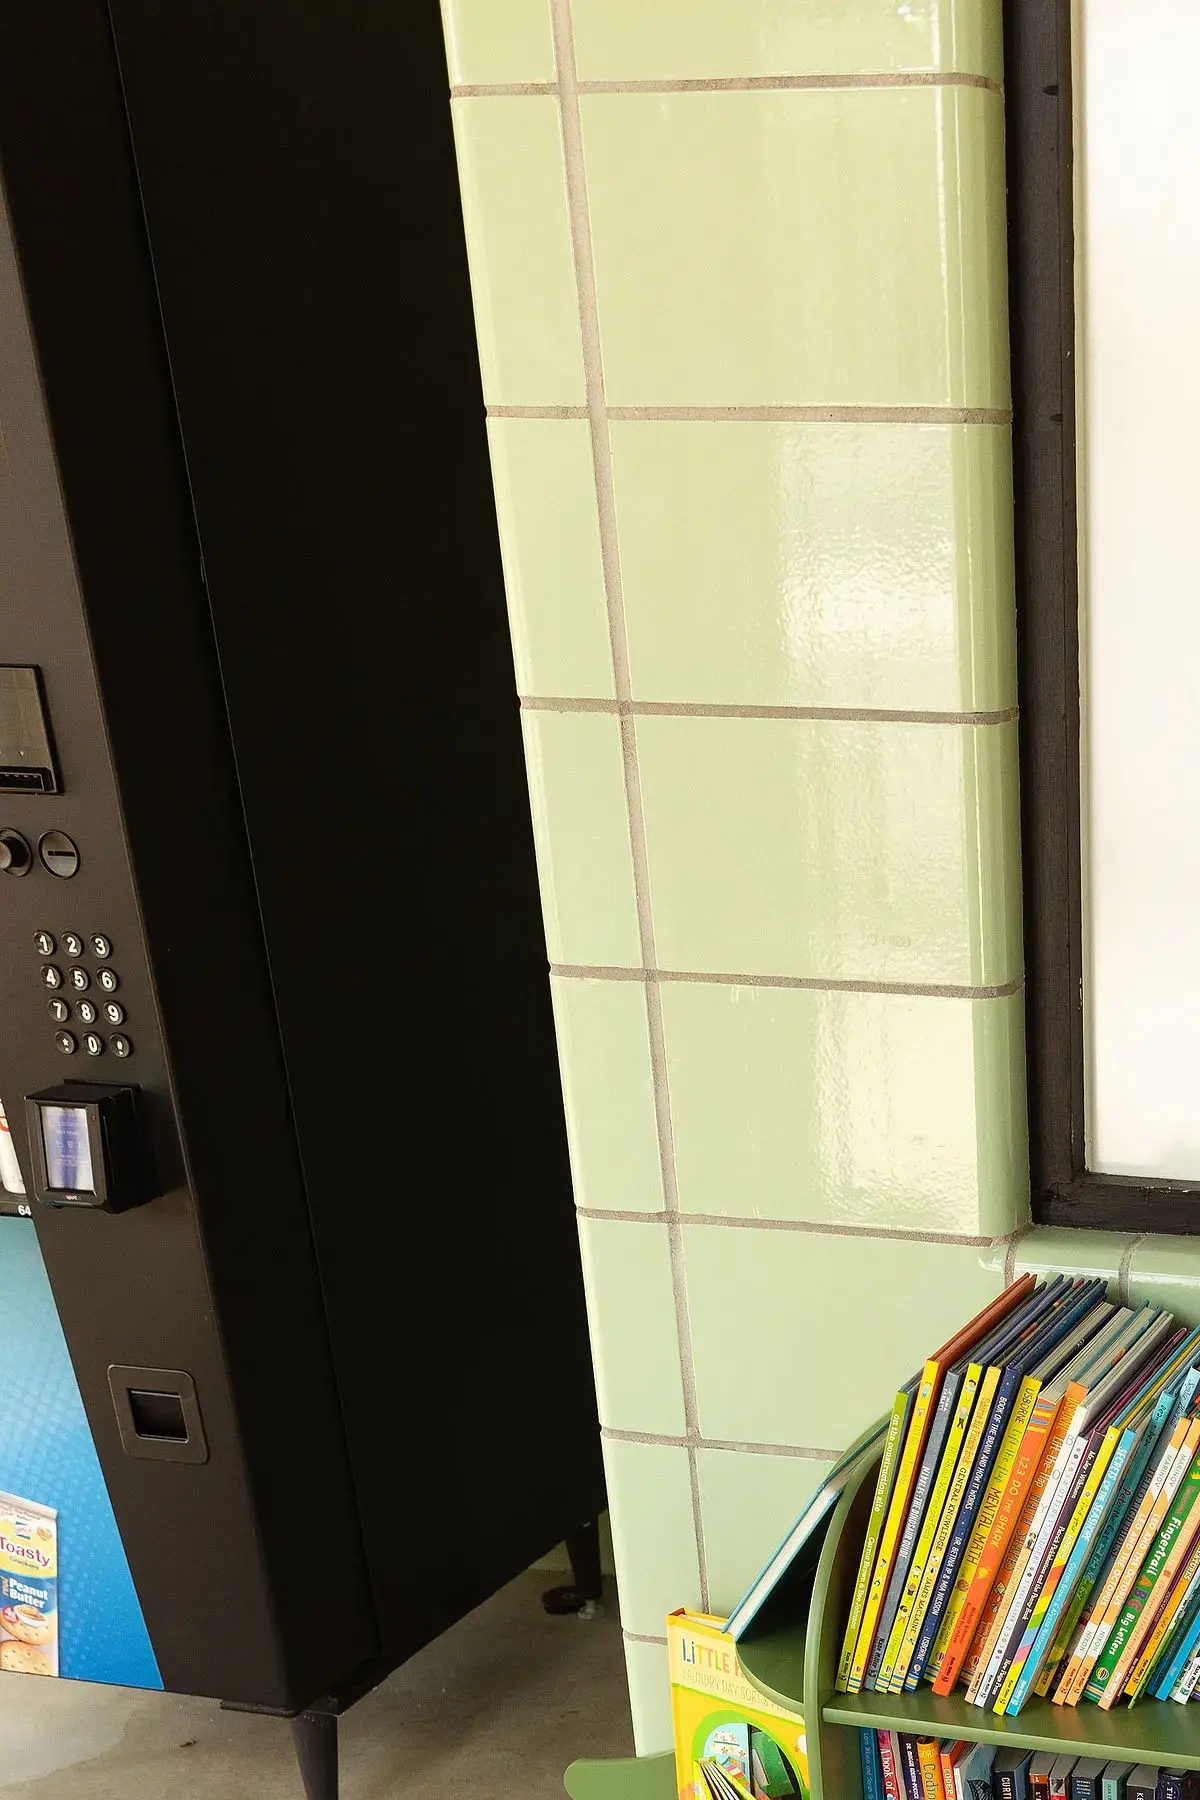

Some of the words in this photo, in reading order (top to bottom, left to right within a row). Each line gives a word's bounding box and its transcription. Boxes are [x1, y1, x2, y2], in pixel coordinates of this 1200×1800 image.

[40, 935, 48, 952] 1
[67, 936, 77, 953] 2
[95, 938, 105, 954] 3
[46, 968, 56, 985] 4
[74, 971, 84, 987] 5
[102, 971, 113, 989] 6
[53, 1003, 61, 1018] 7
[81, 1004, 91, 1020] 8
[108, 1005, 119, 1022] 9
[88, 1036, 98, 1053] 0
[18, 1205, 32, 1216] 64
[994, 1396, 1007, 1415] BOOK
[1014, 1387, 1035, 1424] USBORNE
[891, 1414, 899, 1424] on
[988, 1422, 998, 1434] THE
[992, 1414, 1001, 1423] OF
[888, 1425, 898, 1440] the
[982, 1434, 995, 1453] BRAIN
[877, 1441, 895, 1494] construction
[978, 1453, 988, 1466] AND
[973, 1466, 984, 1481] HOW
[950, 1466, 967, 1502] GENERAL
[970, 1481, 980, 1489] IT
[1007, 1478, 1021, 1496] DO
[873, 1495, 884, 1512] site
[964, 1488, 977, 1510] WORKS
[976, 1486, 1002, 1531] MENTAL
[1002, 1498, 1013, 1513] THE
[935, 1503, 955, 1551] KNOWLEDGE
[989, 1514, 1008, 1547] SHARK
[1146, 1512, 1160, 1530] LEO
[1052, 1525, 1064, 1544] Patrick
[1137, 1529, 1152, 1549] AND
[0, 1536, 50, 1567] Toasty
[965, 1532, 986, 1565] MATH
[1143, 1514, 1182, 1576] Fingertrail
[1038, 1543, 1057, 1577] Picklebottom
[1131, 1548, 1144, 1564] THE
[9, 1577, 49, 1601] Peanut
[1031, 1586, 1039, 1595] the
[1034, 1576, 1043, 1588] and
[1111, 1563, 1137, 1607] OCTOPUS
[9, 1589, 46, 1609] Butter
[1024, 1595, 1036, 1610] Penny
[1020, 1609, 1030, 1620] Book
[1120, 1611, 1135, 1626] Big
[1107, 1625, 1128, 1657] Letters
